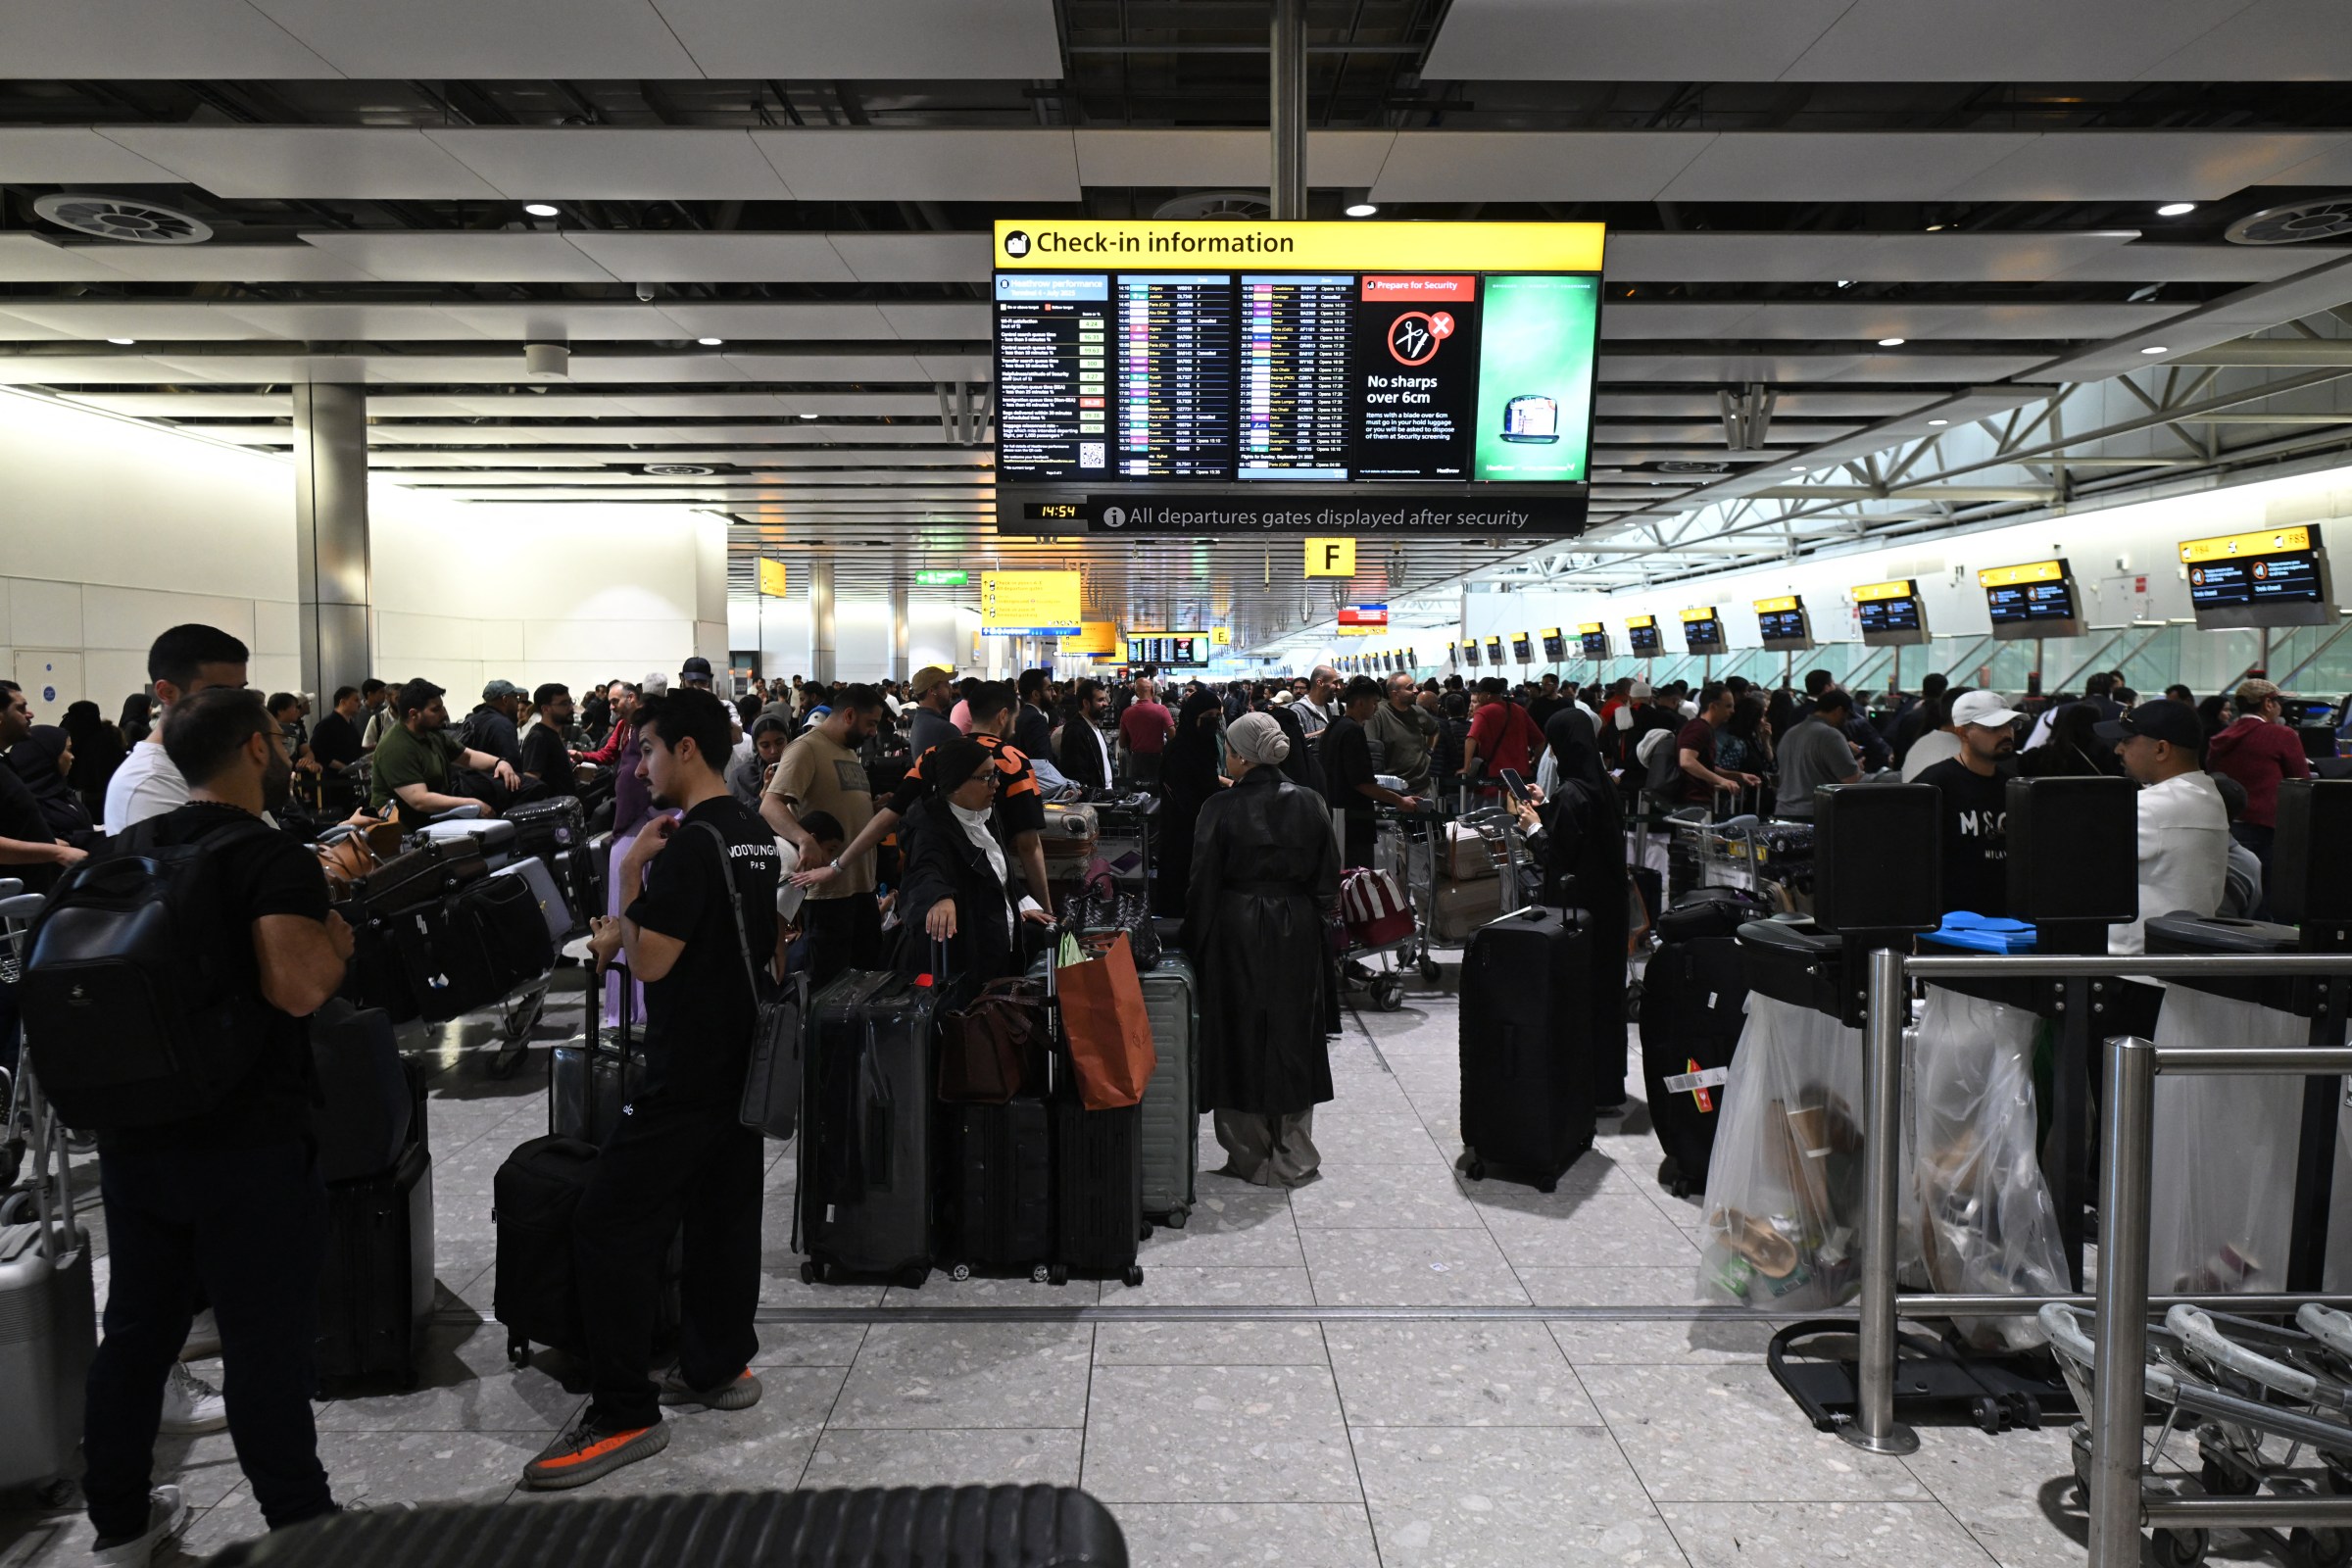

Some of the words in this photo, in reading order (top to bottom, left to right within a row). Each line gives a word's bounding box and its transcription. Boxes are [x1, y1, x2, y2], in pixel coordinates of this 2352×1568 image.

[1037, 231, 1140, 253] Check-in
[1149, 230, 1295, 253] information
[1011, 279, 1051, 288] Heathrow
[1053, 279, 1102, 290] performance
[1377, 281, 1408, 290] Prepare
[1424, 281, 1457, 290] Security
[1367, 374, 1389, 388] No
[1390, 374, 1438, 391] sharps
[1367, 393, 1399, 404] over
[1402, 391, 1430, 404] 6cm
[1043, 506, 1075, 517] 14:54
[1129, 507, 1153, 524] All
[1158, 507, 1257, 529] departures
[1262, 510, 1311, 529] gates
[1316, 508, 1405, 529] displayed
[1408, 508, 1450, 526] after
[1455, 509, 1531, 531] security
[1325, 544, 1341, 570] F
[1219, 632, 1224, 642] E
